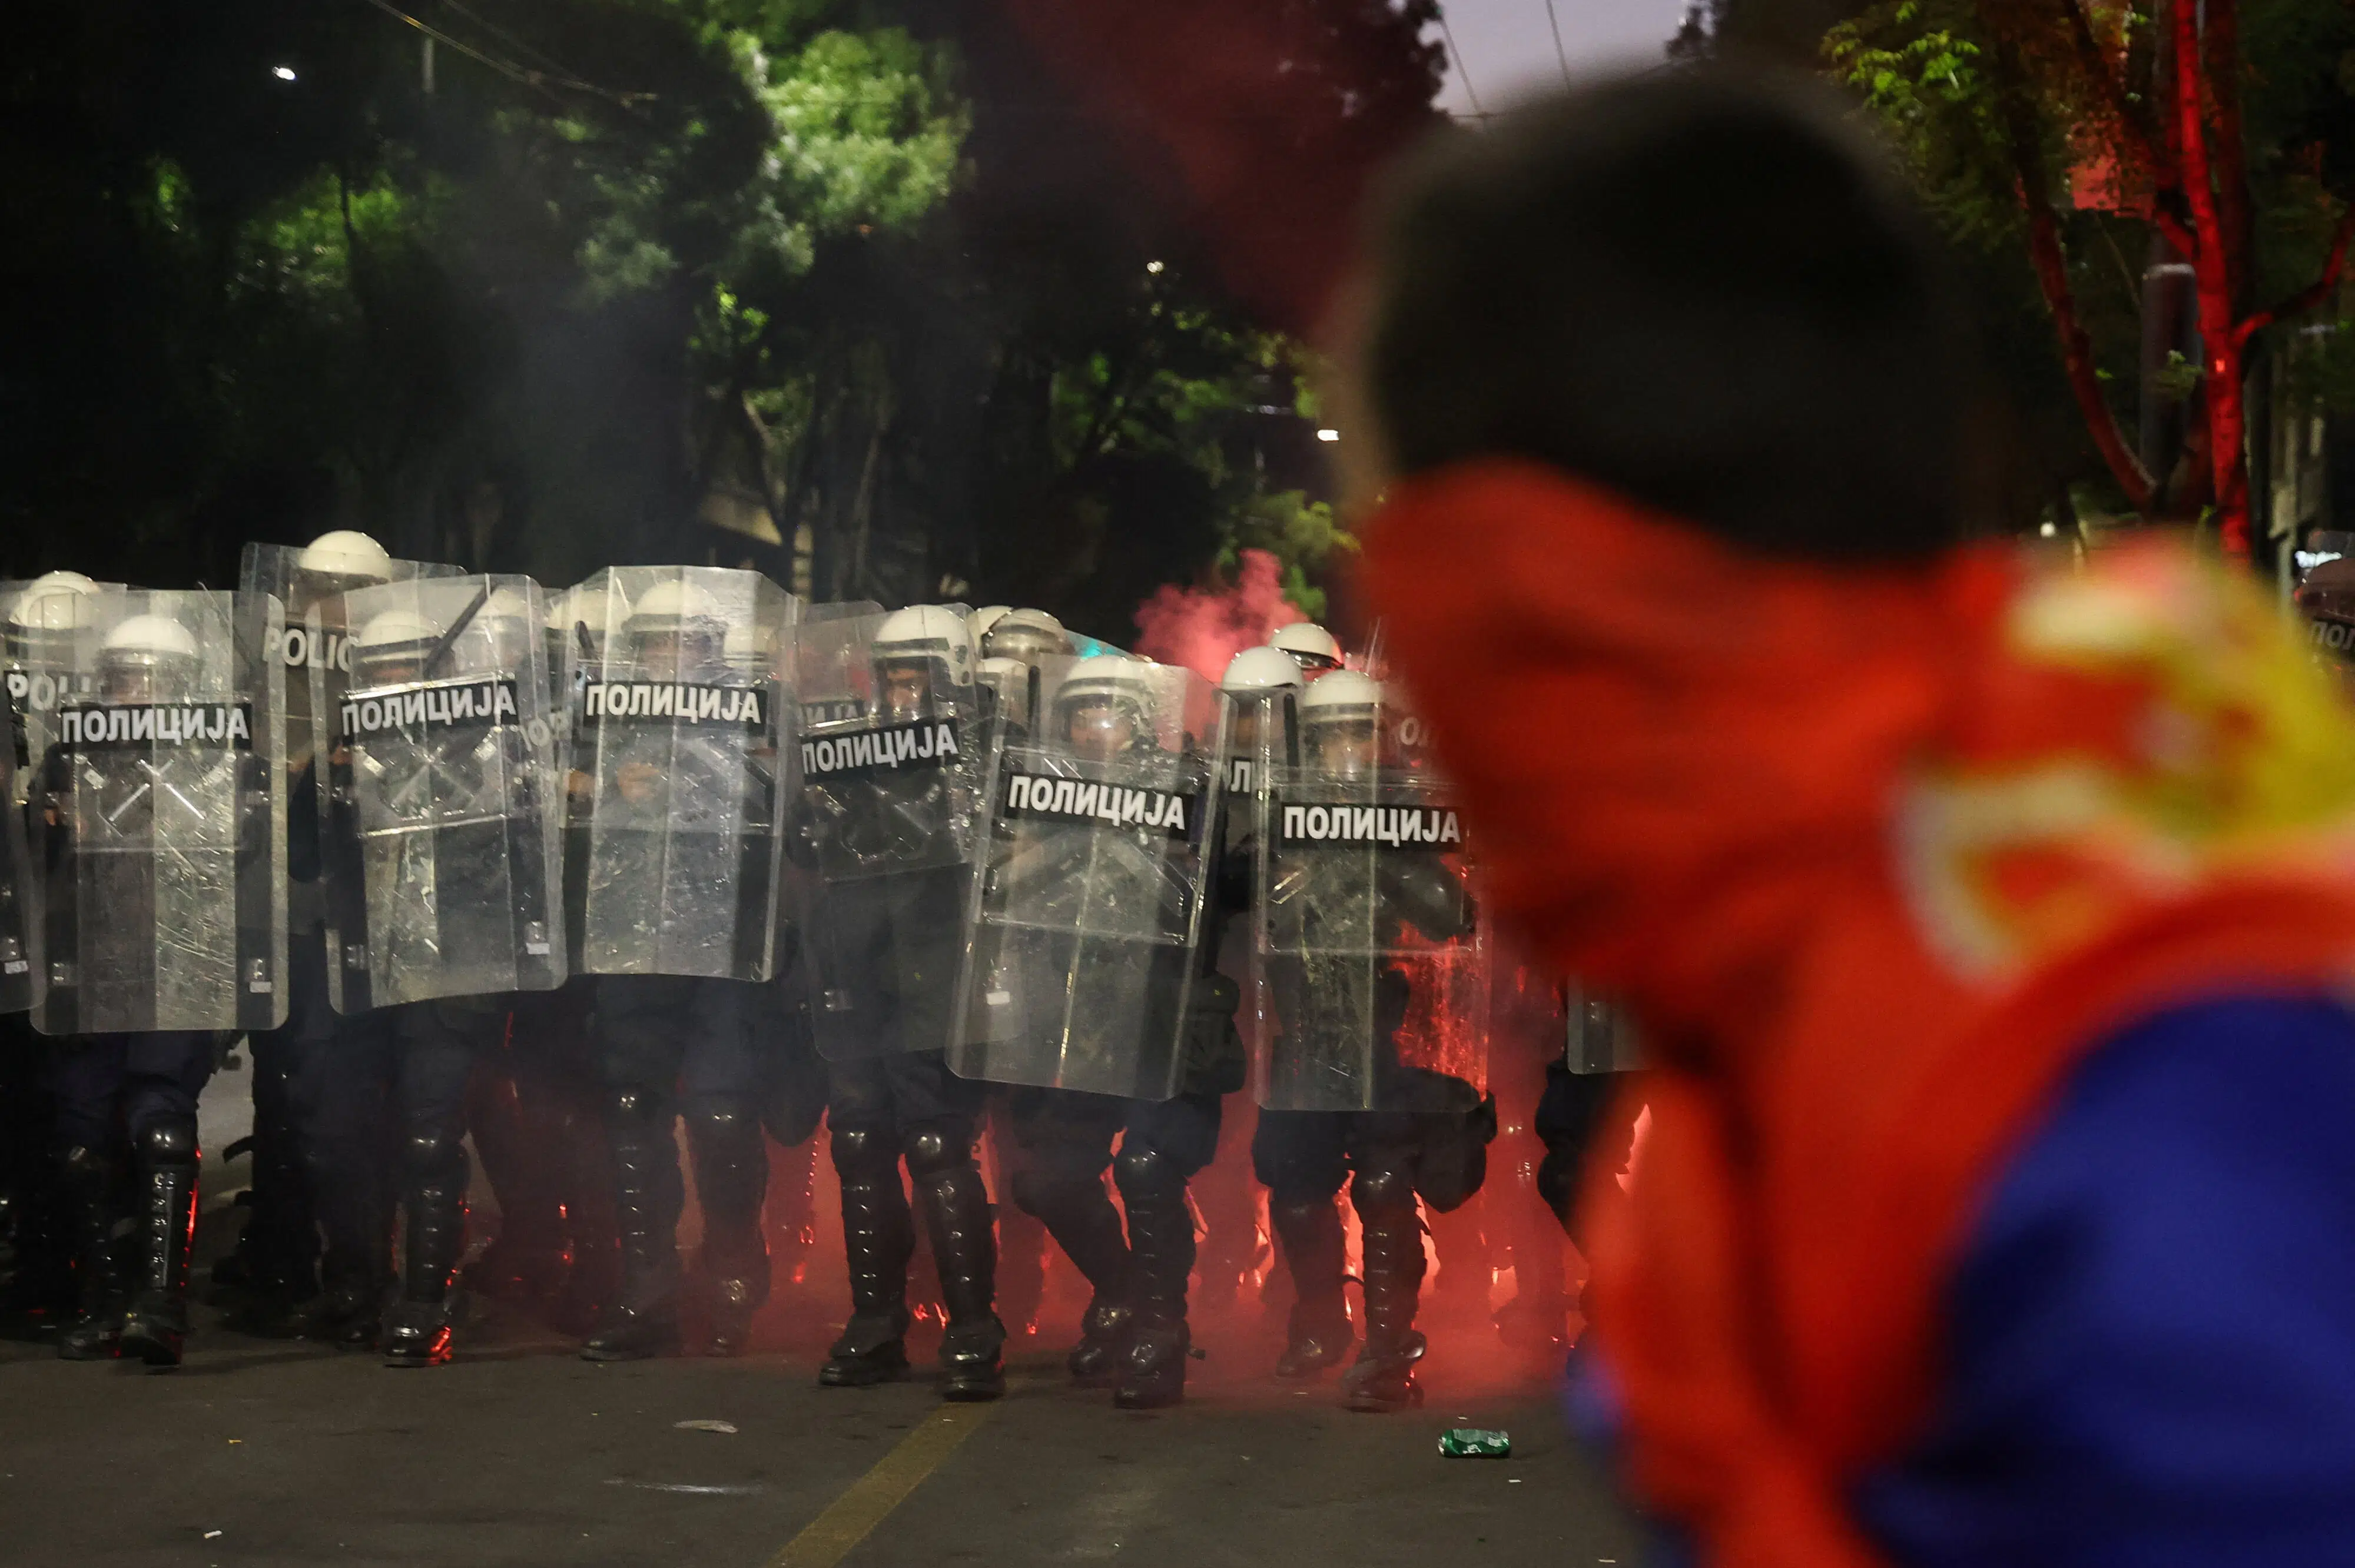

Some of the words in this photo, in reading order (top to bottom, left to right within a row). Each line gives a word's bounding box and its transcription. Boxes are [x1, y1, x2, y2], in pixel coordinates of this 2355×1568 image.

[62, 707, 250, 746] ПОЛИЦИЈА
[342, 685, 516, 736] ПОЛИЦИЈА
[586, 684, 761, 724] ПОЛИЦИЈА
[801, 723, 959, 774] ПОЛИЦИЈА
[1007, 775, 1186, 830] ПОЛИЦИЈА
[1283, 806, 1461, 848] ПОЛИЦИЈА
